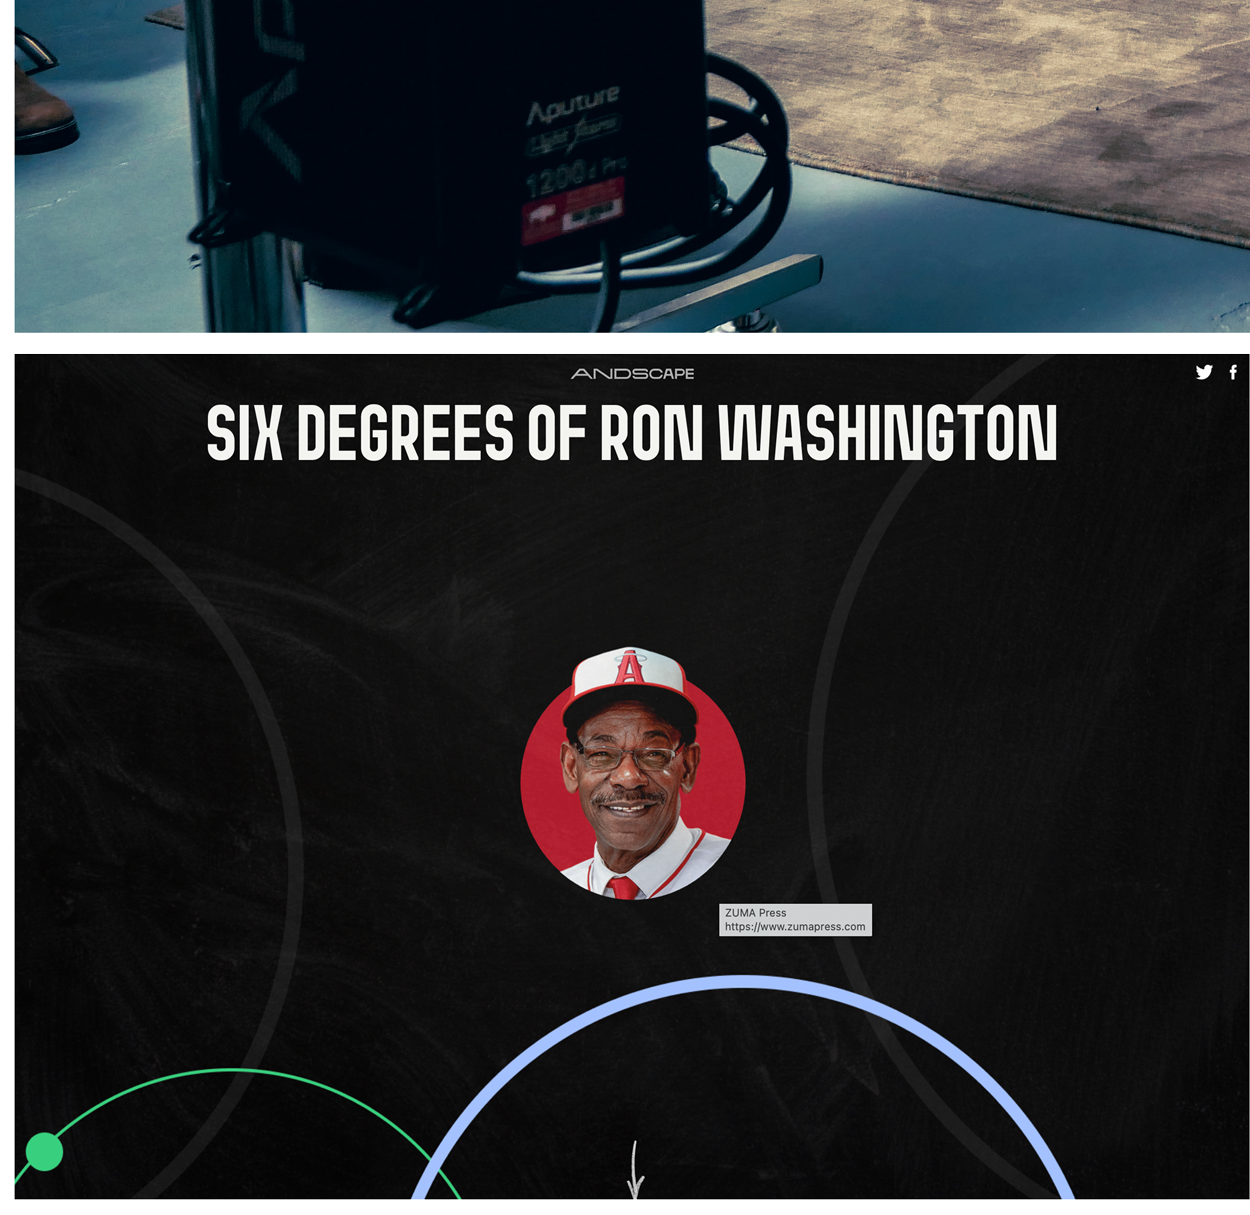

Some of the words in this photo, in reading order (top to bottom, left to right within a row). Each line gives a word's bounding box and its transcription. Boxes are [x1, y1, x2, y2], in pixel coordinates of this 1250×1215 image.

[525, 85, 621, 128] Aputure
[570, 367, 695, 380] ANDSCAPE
[207, 403, 284, 462] SIX
[298, 403, 514, 462] DEGREES
[528, 403, 587, 462] OF
[601, 403, 703, 462] RON
[718, 403, 1057, 462] WASHINGTON
[615, 649, 646, 684] A
[725, 908, 757, 918] ZUMA
[759, 908, 787, 918] Press
[725, 921, 866, 933] https://www.zumapress.com
